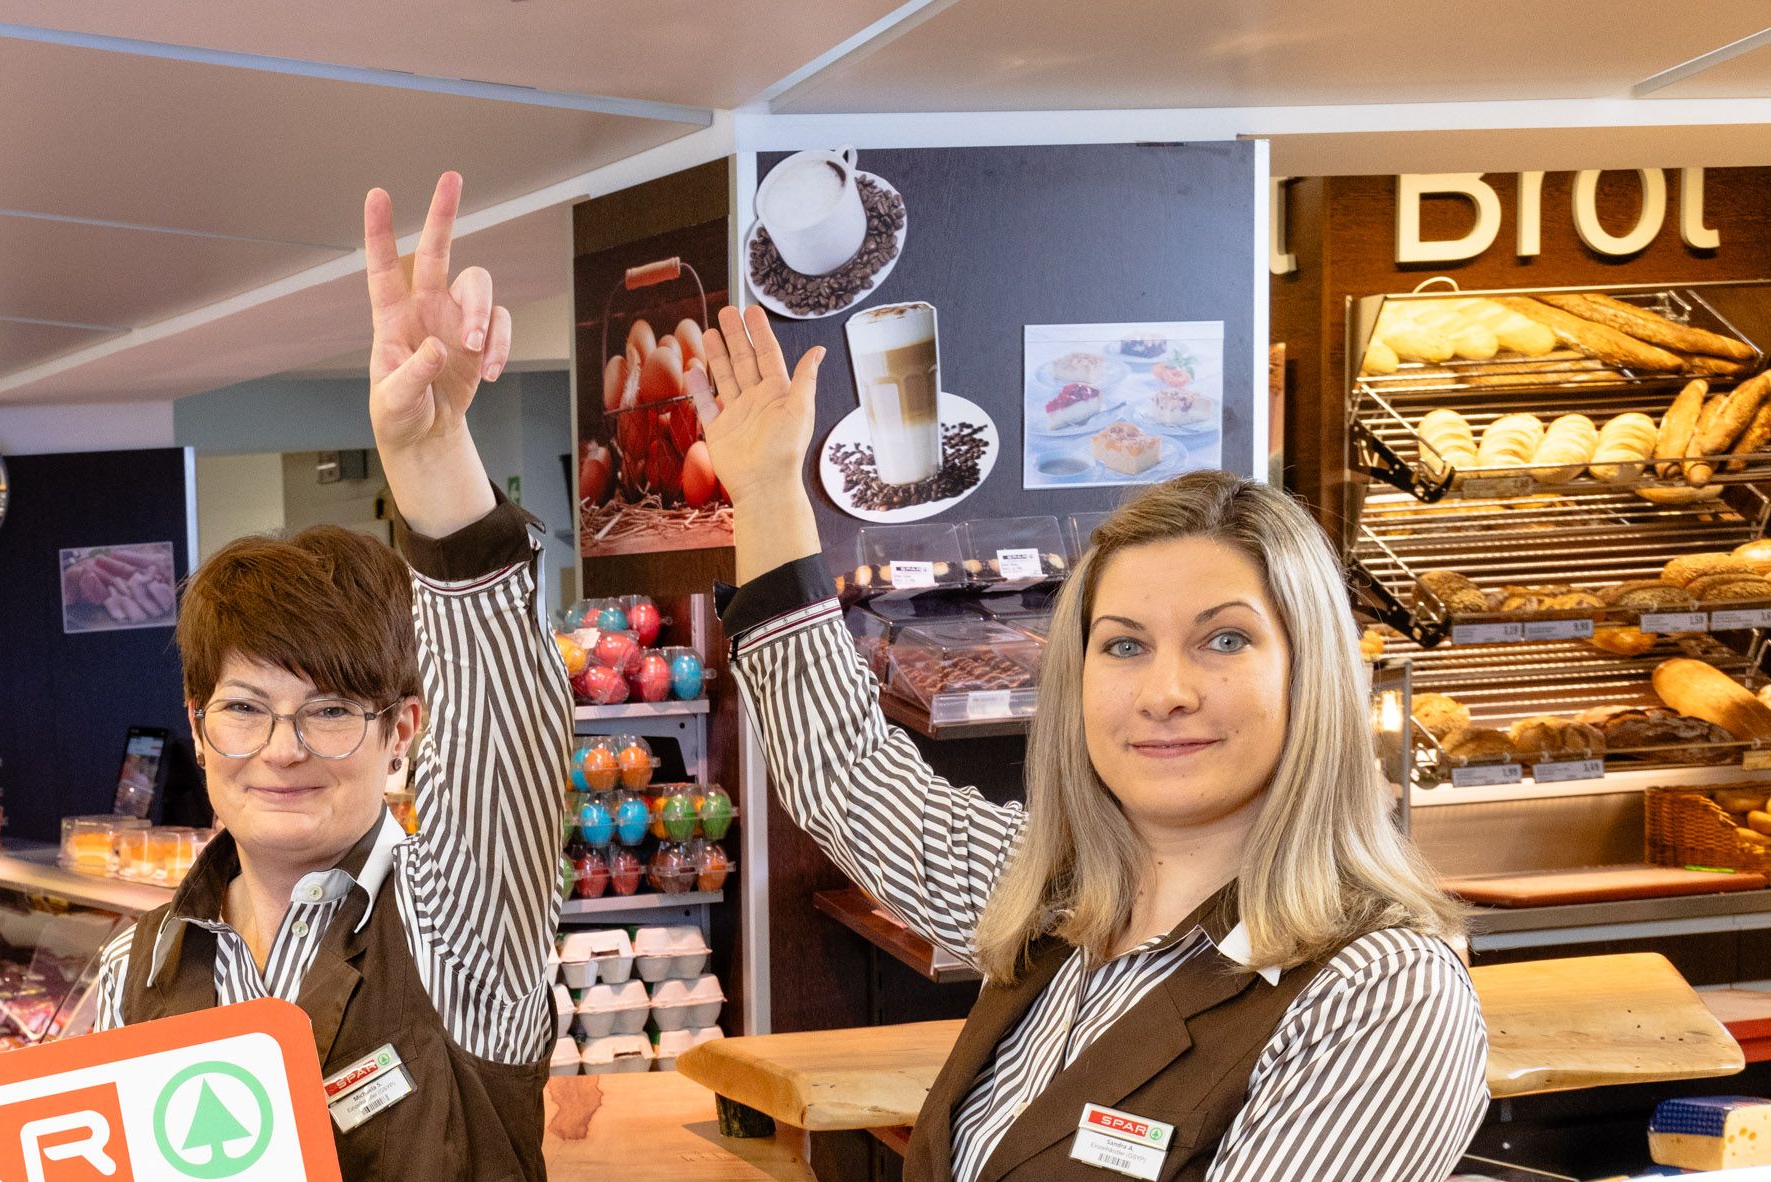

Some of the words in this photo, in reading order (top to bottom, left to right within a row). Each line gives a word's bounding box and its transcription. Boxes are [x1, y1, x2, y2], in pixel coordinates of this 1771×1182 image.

[1396, 168, 1721, 264] Brot
[335, 1061, 378, 1090] SPAR
[1100, 1115, 1148, 1136] SPAR
[1106, 1138, 1128, 1152] Sandra
